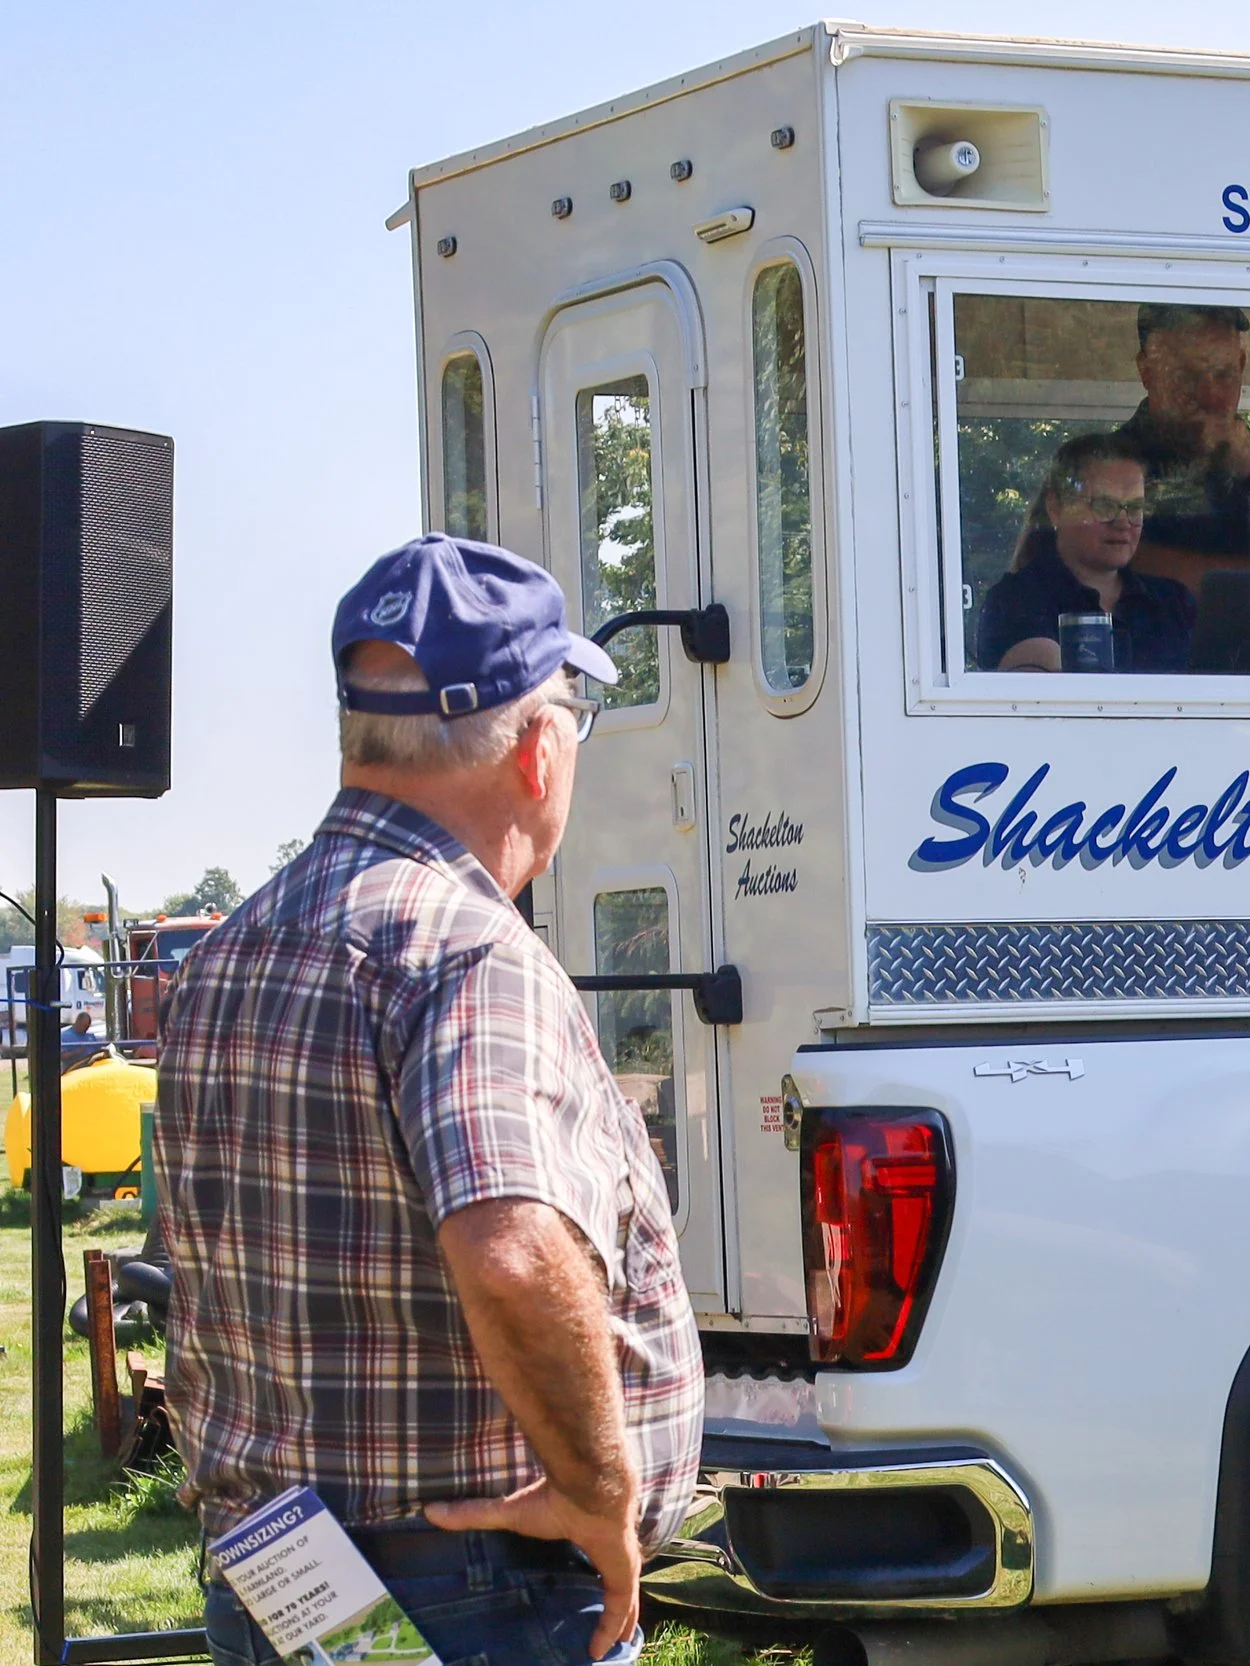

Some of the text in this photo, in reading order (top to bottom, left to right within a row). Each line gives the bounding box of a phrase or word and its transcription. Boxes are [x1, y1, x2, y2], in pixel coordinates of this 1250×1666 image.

[726, 810, 804, 854] Shackelton
[734, 858, 799, 901] Auctions
[763, 1105, 780, 1113] DO NOT
[764, 1115, 780, 1123] BLOCK
[255, 1545, 295, 1572] AUCTION
[277, 1577, 290, 1588] OR
[311, 1591, 337, 1610] YOUR
[284, 1626, 302, 1641] OUR
